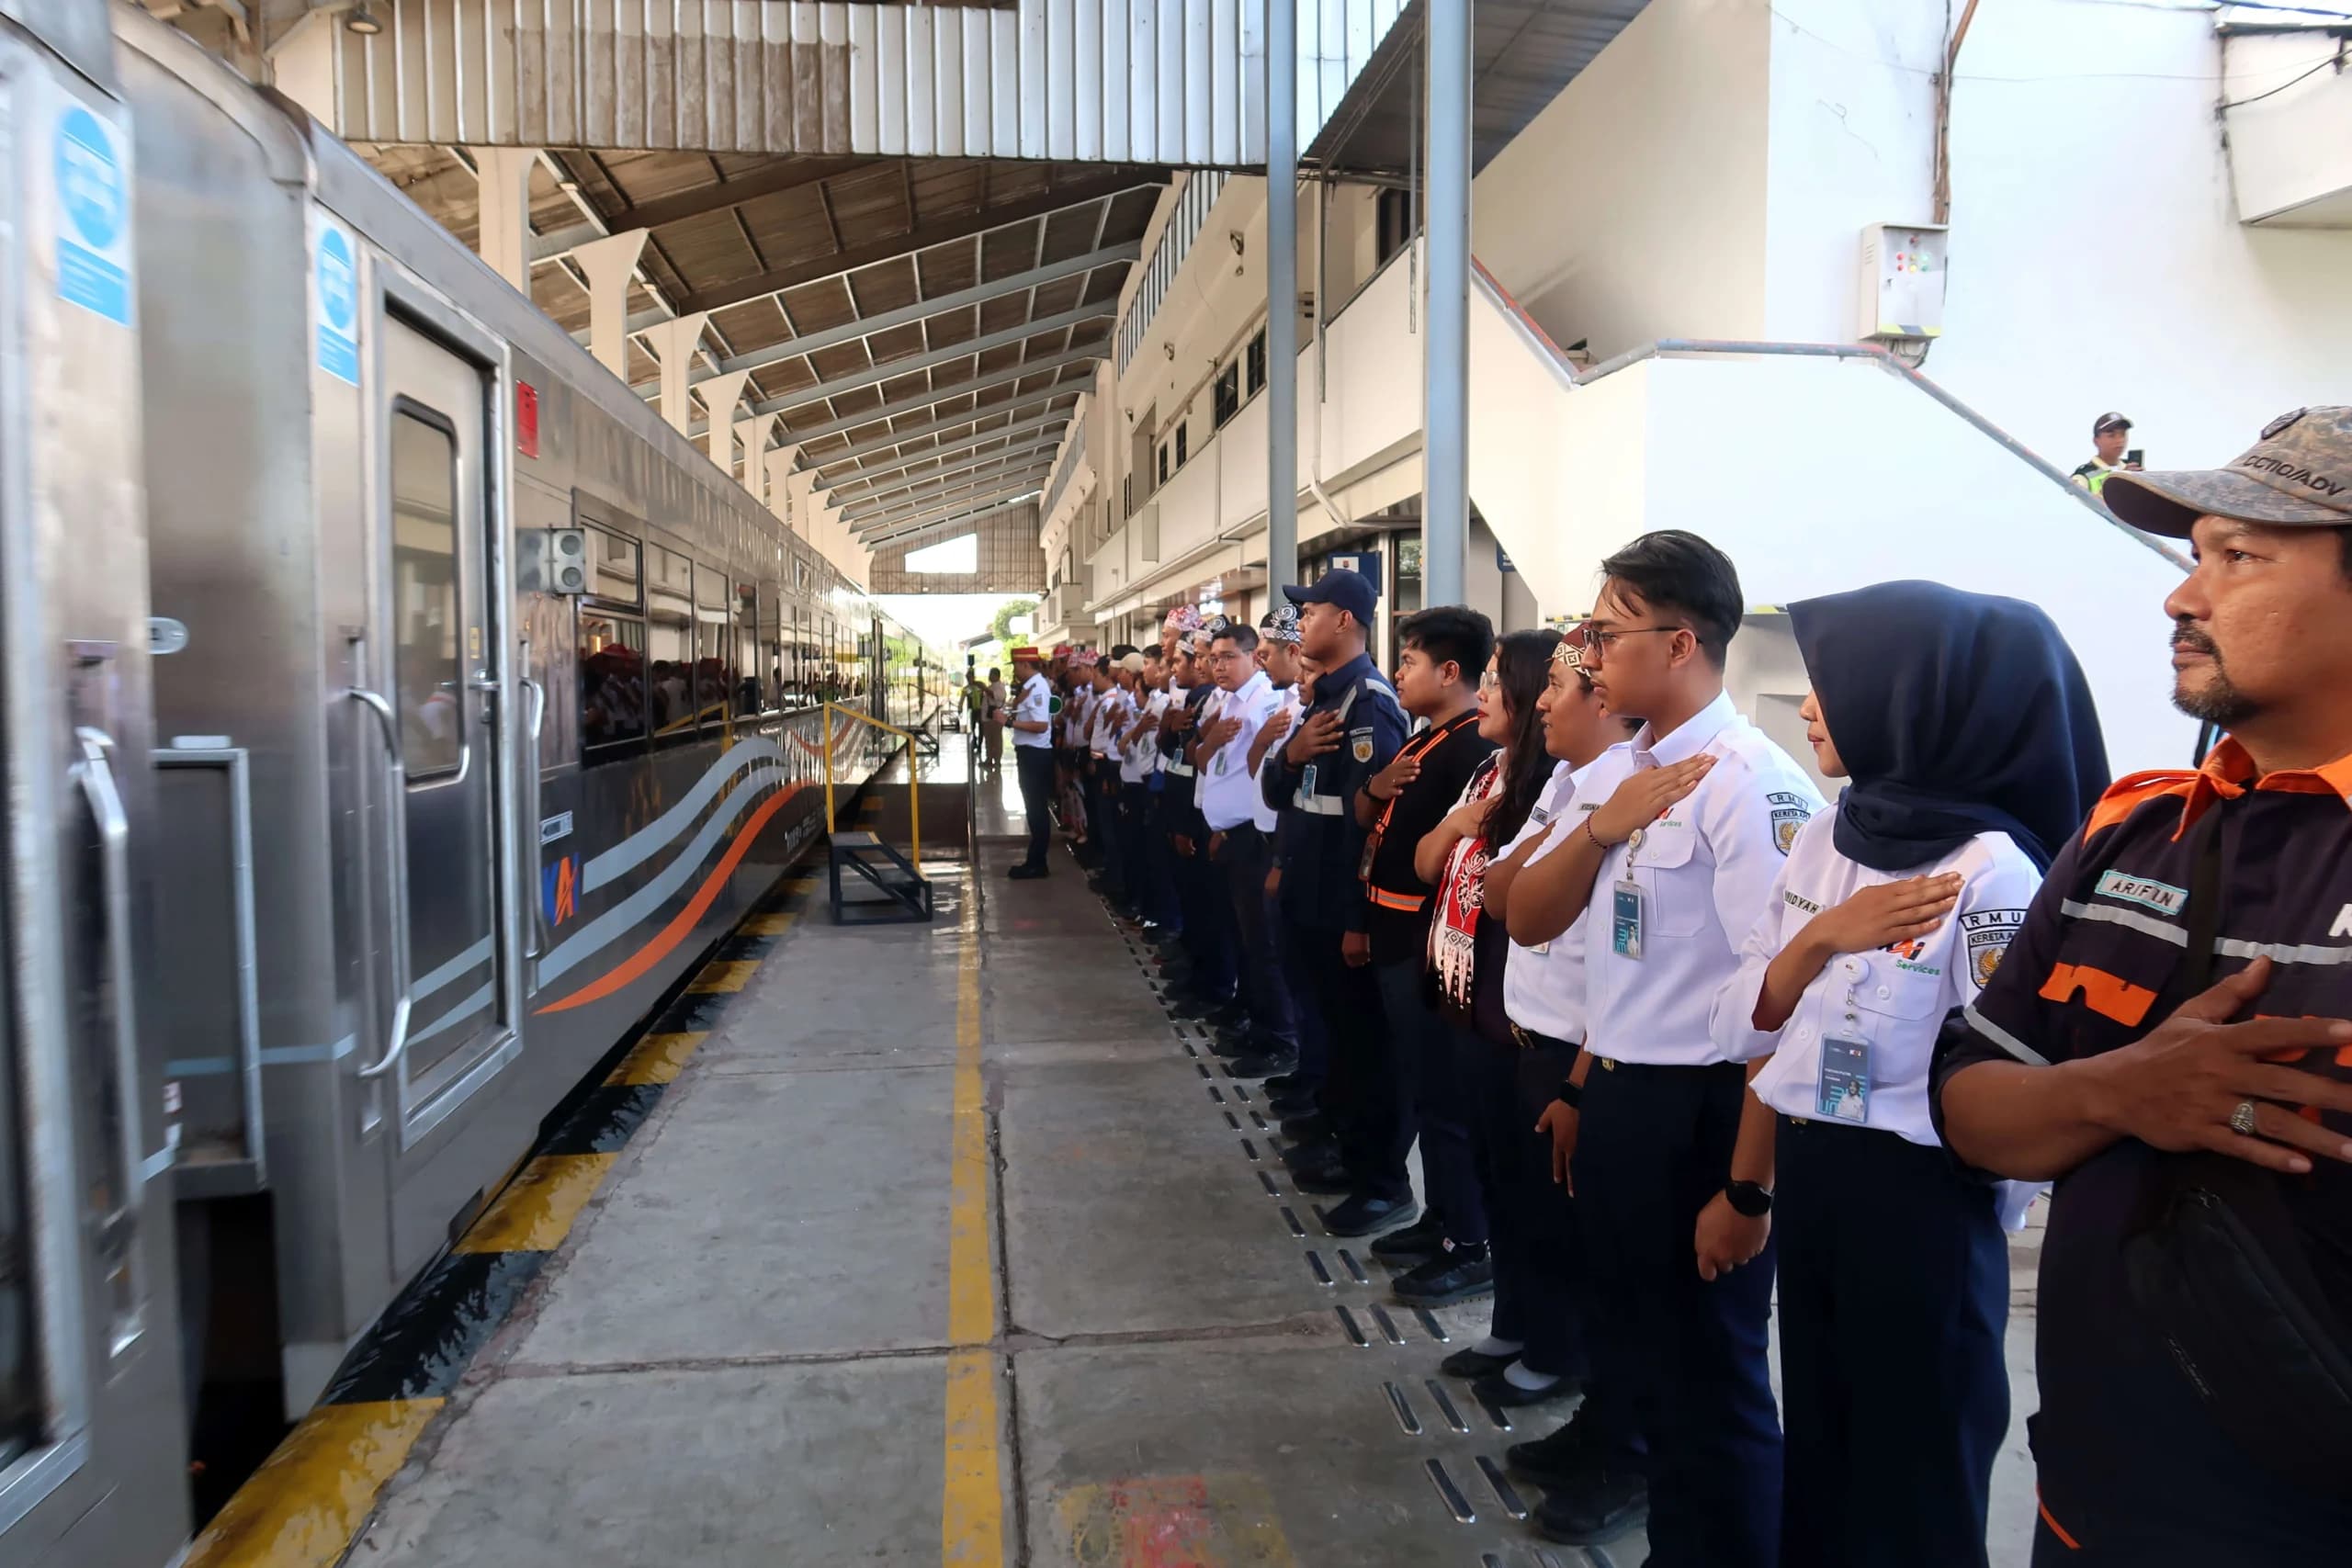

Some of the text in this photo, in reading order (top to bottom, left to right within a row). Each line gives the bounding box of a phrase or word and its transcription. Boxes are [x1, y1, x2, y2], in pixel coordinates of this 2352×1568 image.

[2110, 879, 2175, 907] ARIFIN
[1971, 931, 2006, 945] KERETA
[1895, 959, 1941, 976] Services
